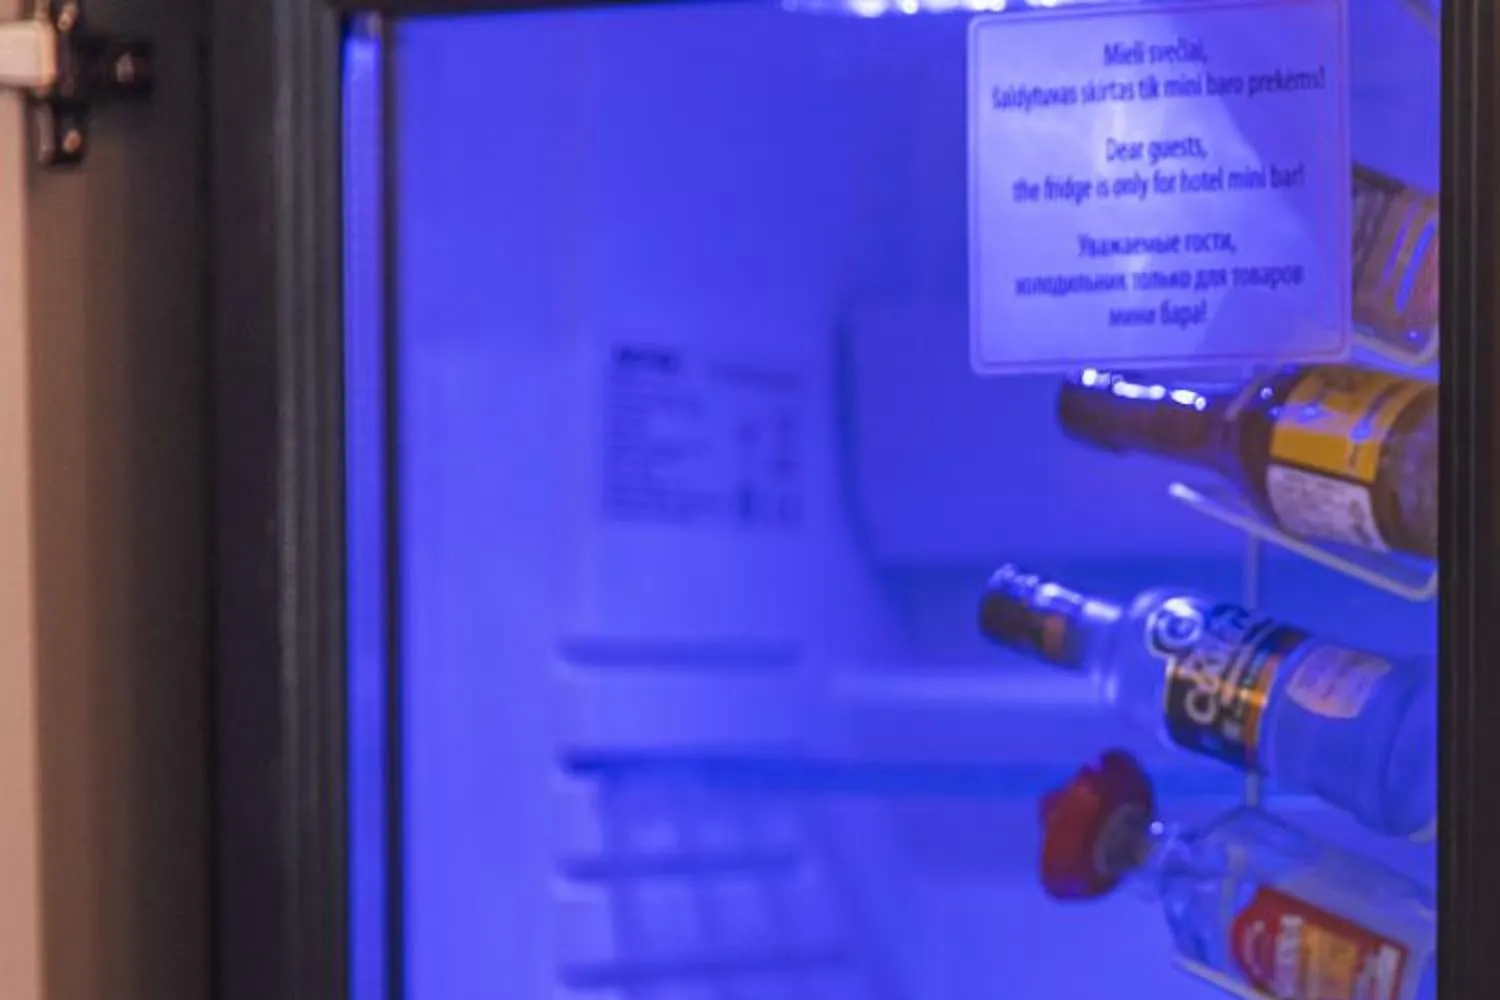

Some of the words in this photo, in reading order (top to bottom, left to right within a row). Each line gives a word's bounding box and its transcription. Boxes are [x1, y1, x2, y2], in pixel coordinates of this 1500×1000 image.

[1138, 74, 1159, 99] tik
[1164, 71, 1202, 97] mini
[1206, 71, 1244, 96] baro
[1106, 138, 1145, 161] Dear
[1148, 137, 1208, 163] guests,
[1012, 178, 1041, 202] the
[1044, 174, 1092, 206] fridge
[1096, 178, 1109, 198] is
[1113, 171, 1148, 200] only
[1153, 170, 1177, 195] for
[1180, 167, 1224, 192] hotel
[1228, 166, 1266, 189] mini
[1271, 162, 1306, 188] bar!
[1185, 232, 1237, 255] гости,
[1195, 269, 1228, 292] для
[1232, 264, 1304, 290] товаров
